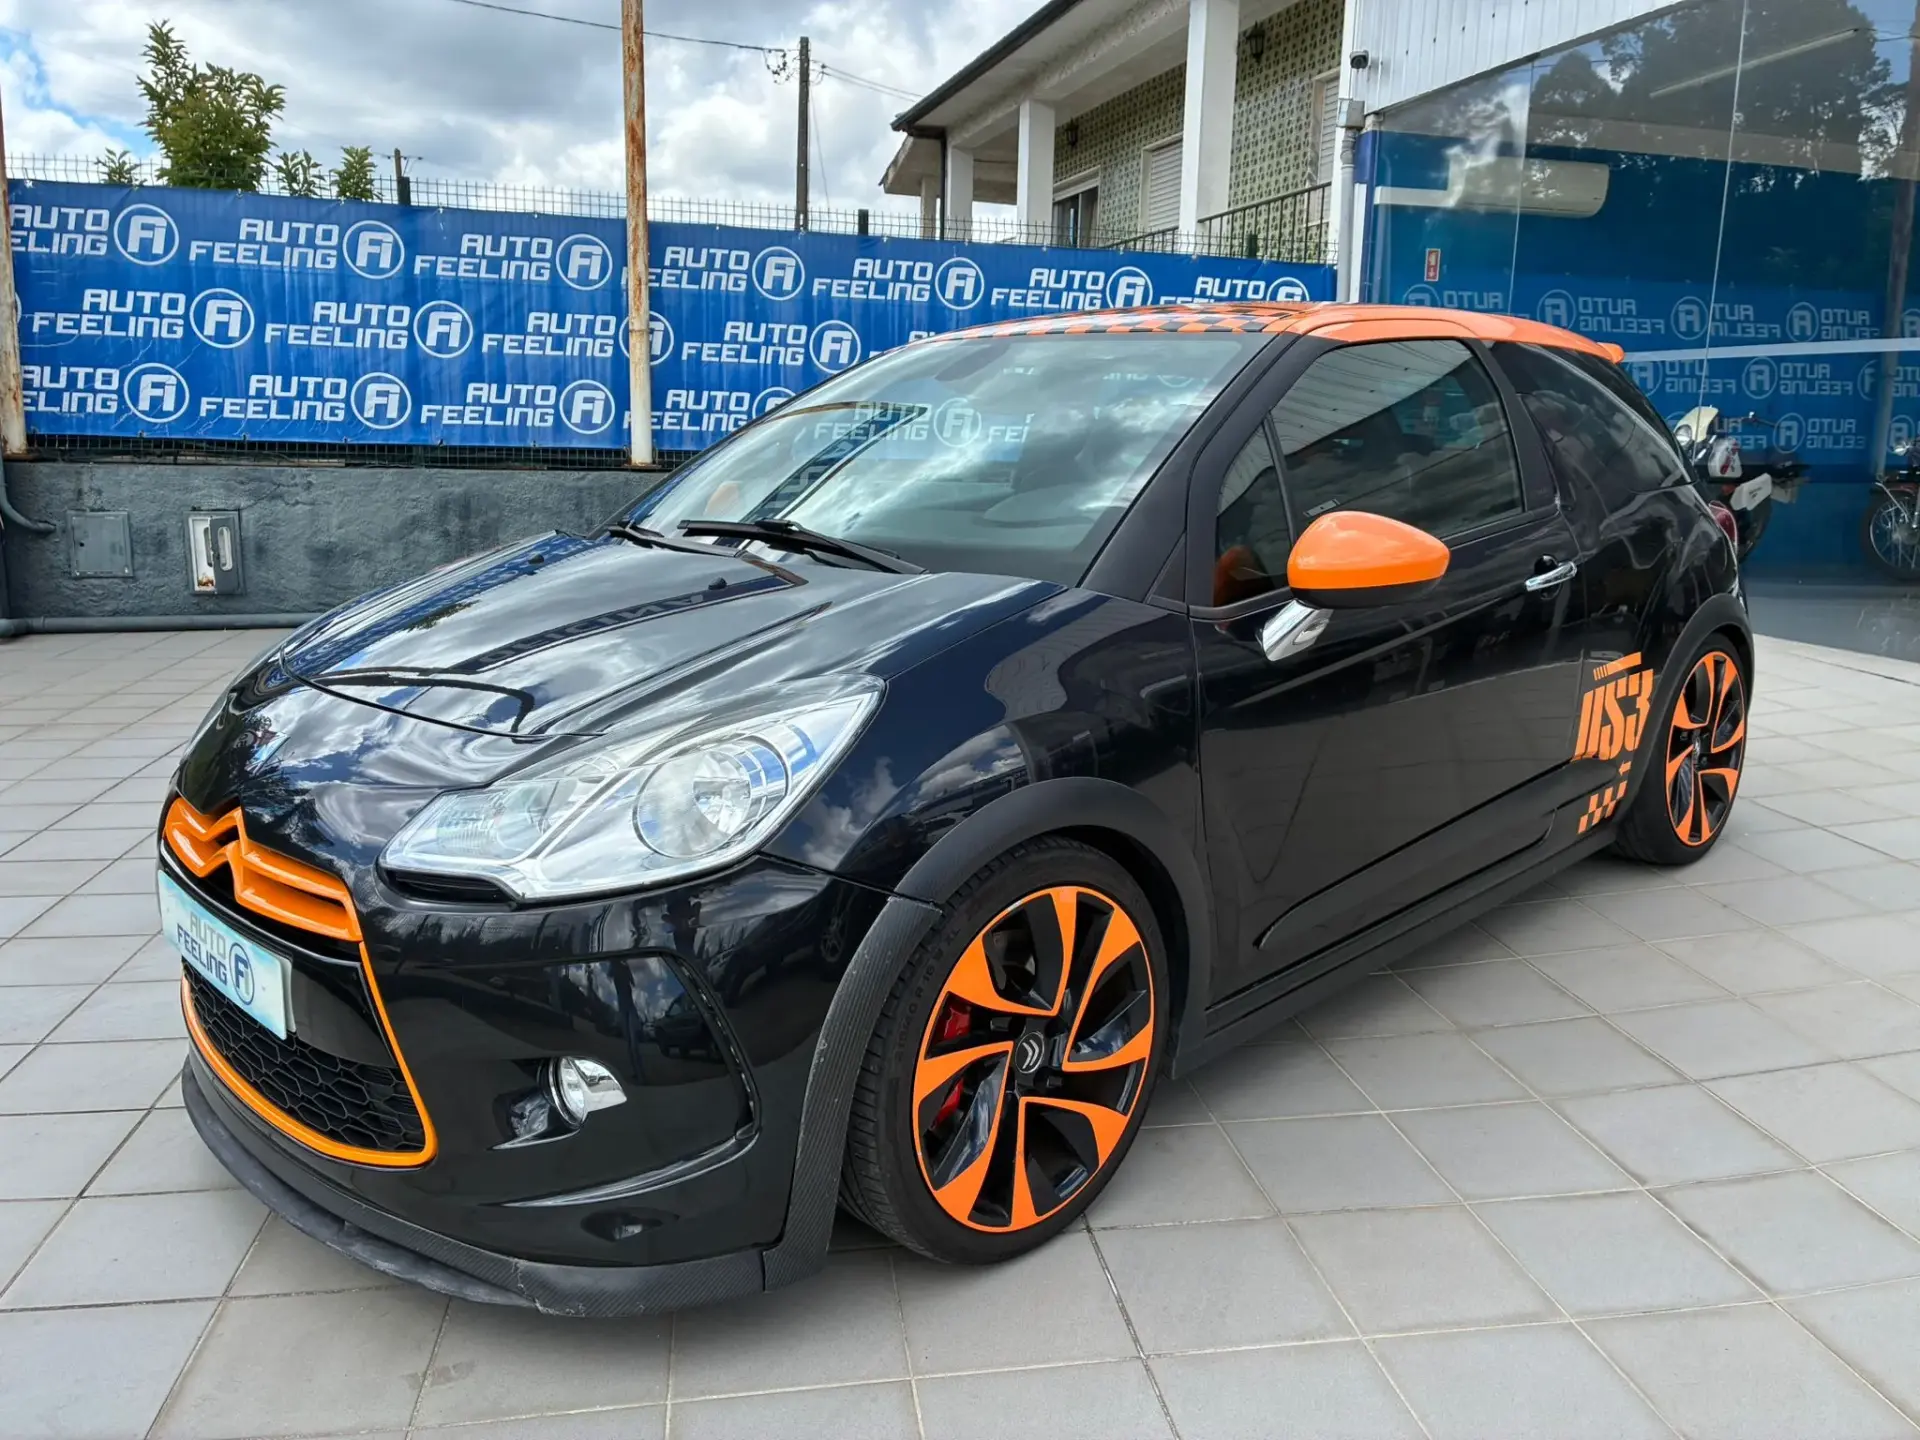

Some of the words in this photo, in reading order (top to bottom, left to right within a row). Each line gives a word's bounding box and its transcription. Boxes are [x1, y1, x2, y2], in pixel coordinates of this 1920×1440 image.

[9, 204, 110, 232] AUTO
[11, 230, 108, 256] ELING
[239, 218, 339, 246] AUTO
[189, 240, 337, 269] FEELING
[461, 233, 553, 259] AUTO
[664, 246, 750, 270] AUTO
[413, 255, 550, 281] FEELING
[853, 258, 933, 281] AUTO
[1029, 267, 1105, 290] AUTO
[812, 278, 930, 302] FEELING
[990, 288, 1101, 310] FEELING
[1194, 276, 1266, 299] AUTO
[82, 289, 186, 315] AUTO
[313, 301, 410, 327] AUTO
[32, 312, 184, 339] FEELING
[264, 323, 408, 349] FEELING
[527, 312, 617, 336] AUTO
[724, 321, 808, 345] AUTO
[482, 333, 614, 357] FEELING
[681, 342, 804, 366] FEELING
[21, 365, 120, 390] AUTO
[249, 375, 347, 400] AUTO
[22, 390, 118, 414] ELING
[466, 383, 557, 405] AUTO
[665, 389, 750, 411] AUTO
[200, 397, 345, 421] FEELING
[420, 404, 555, 427] FEELING
[189, 913, 226, 960] AUTO
[176, 922, 228, 987] FEELING
